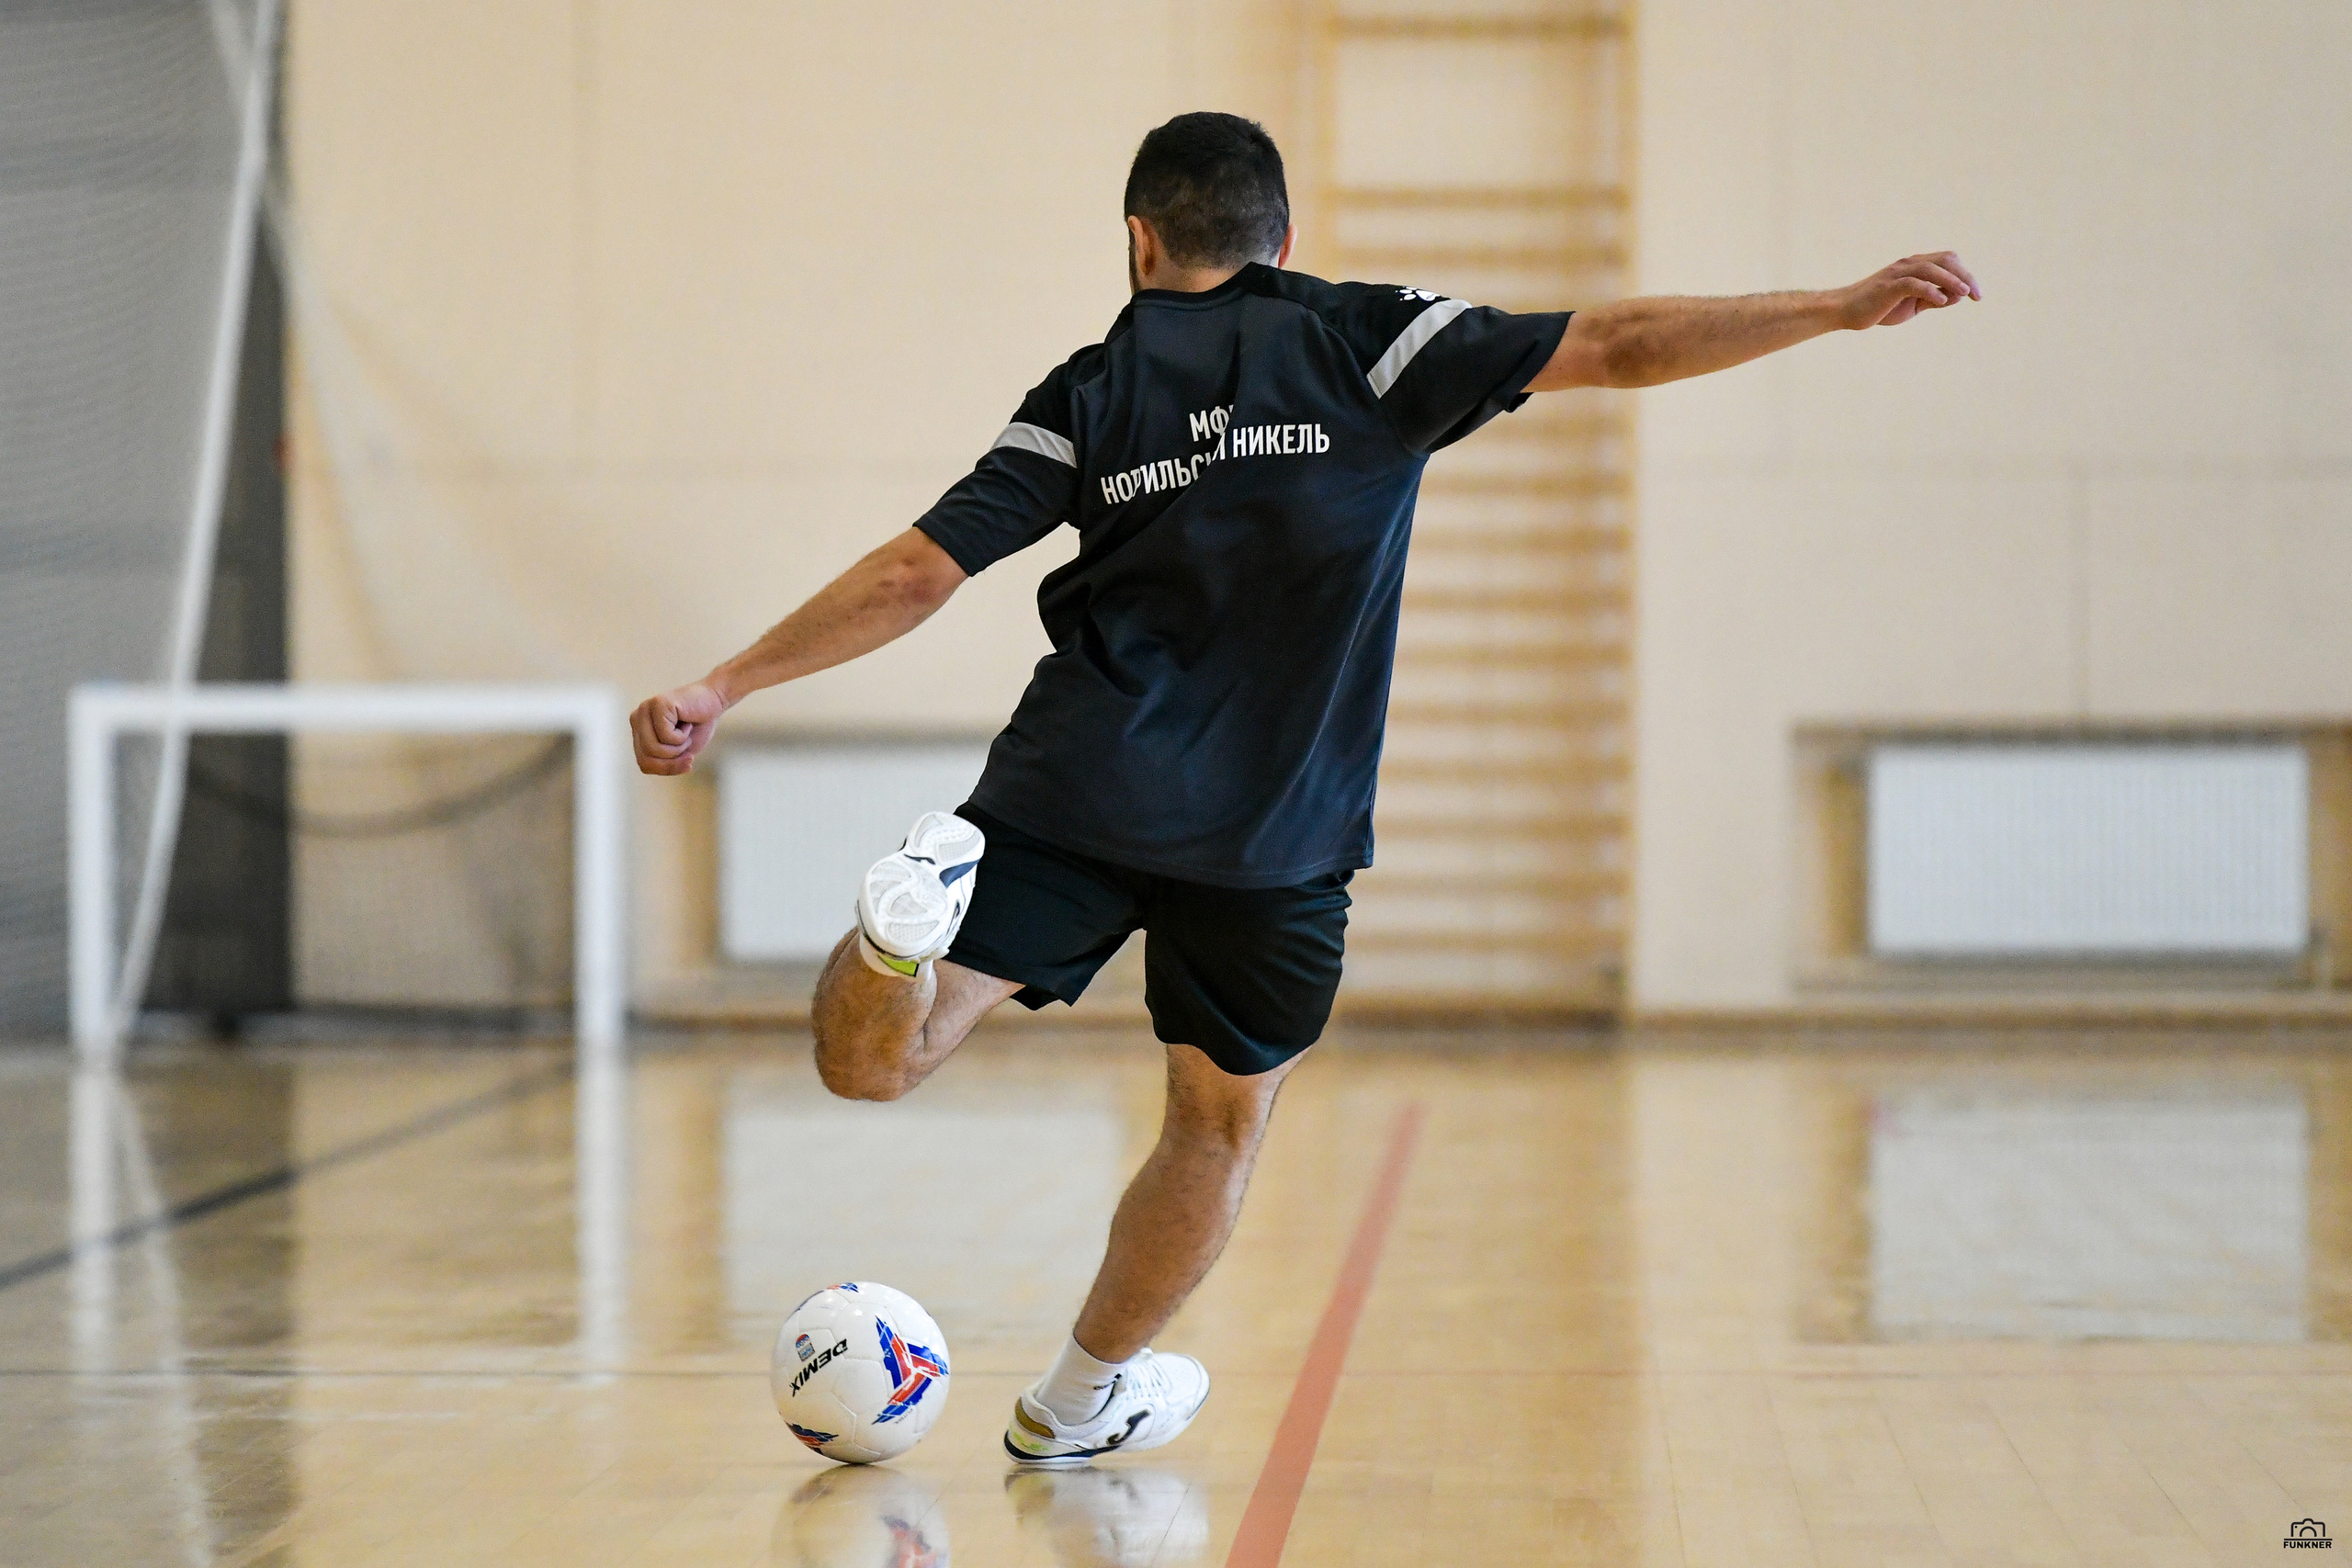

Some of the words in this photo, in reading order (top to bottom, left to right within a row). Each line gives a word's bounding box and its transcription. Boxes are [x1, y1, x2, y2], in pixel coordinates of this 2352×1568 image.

[1189, 404, 1234, 442] МФ
[1232, 423, 1330, 458] НИКЕЛЬ
[790, 1338, 848, 1397] DEMIX
